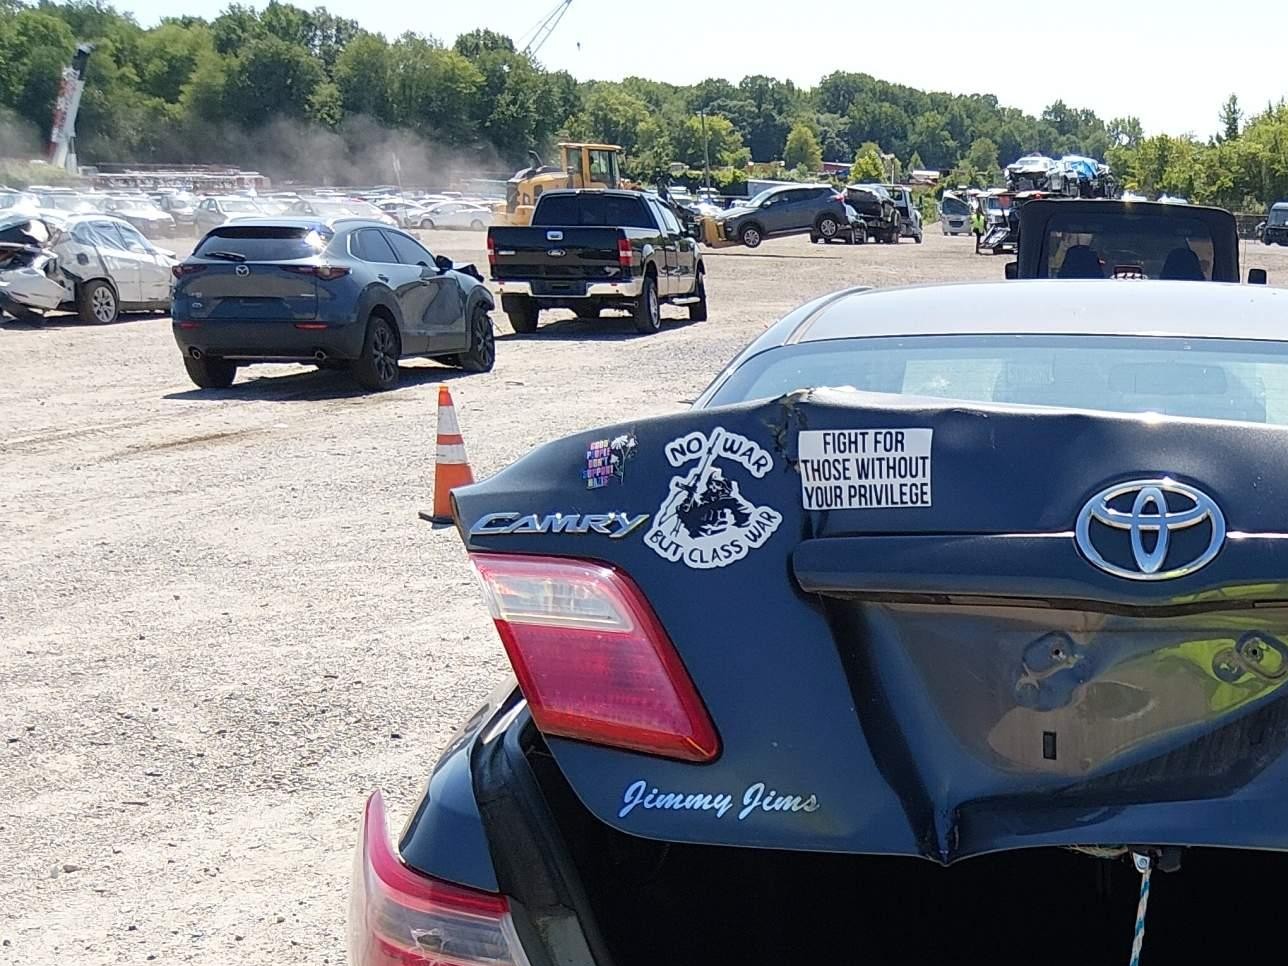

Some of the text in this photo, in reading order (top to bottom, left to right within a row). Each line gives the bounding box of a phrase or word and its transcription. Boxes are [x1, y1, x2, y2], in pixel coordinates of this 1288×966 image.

[670, 437, 769, 473] NO WAR
[822, 431, 905, 455] FIGHT FOR
[801, 456, 929, 482] THOSE WITHOUT
[804, 483, 929, 508] YOUR PRIVILEGE
[470, 512, 650, 538] CAMRY
[649, 510, 778, 564] BUT CLASS WAR
[618, 780, 820, 820] Jimmy Jims
